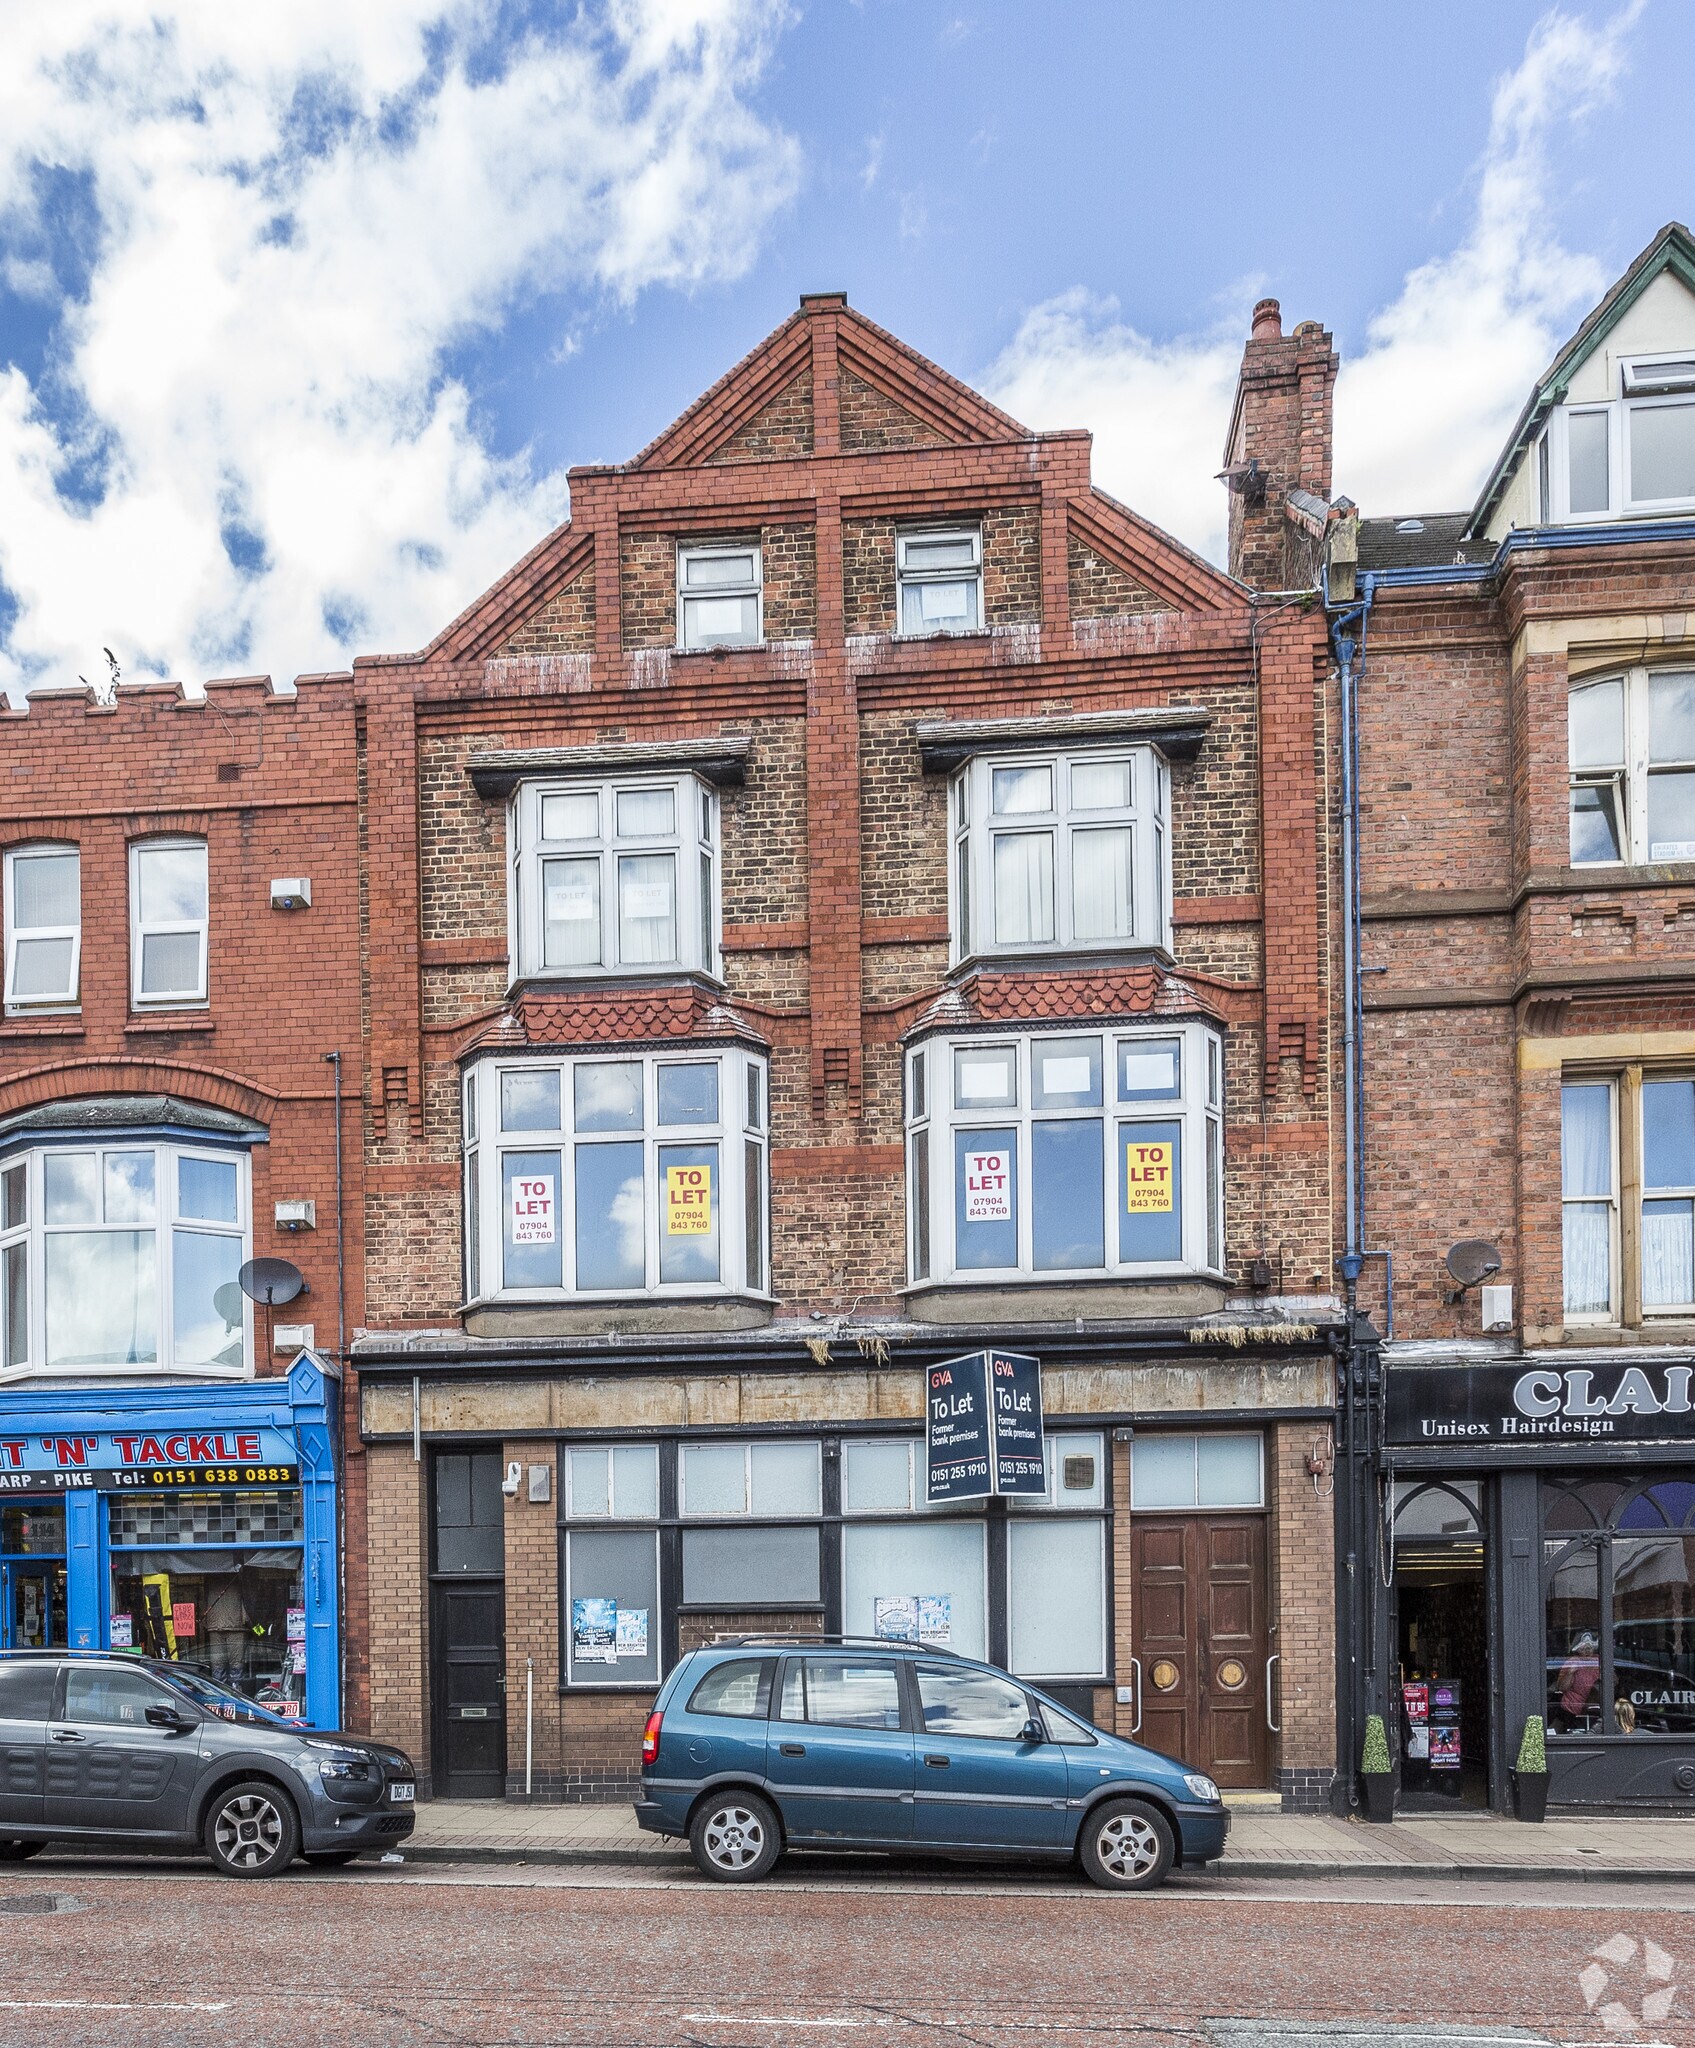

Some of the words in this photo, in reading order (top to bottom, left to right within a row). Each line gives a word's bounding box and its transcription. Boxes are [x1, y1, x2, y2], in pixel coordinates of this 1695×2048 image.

[1136, 1148, 1163, 1163] TO
[974, 1156, 1001, 1171] TO
[676, 1171, 702, 1186] TO
[1130, 1167, 1168, 1182] LET
[520, 1182, 546, 1197] TO
[969, 1175, 1006, 1191] LET
[670, 1190, 707, 1205] LET
[1134, 1189, 1164, 1197] 07904
[515, 1200, 551, 1216] LET
[973, 1197, 1003, 1206] 07904
[1130, 1198, 1149, 1208] 843
[1151, 1198, 1170, 1207] 760
[674, 1211, 704, 1220] 07904
[969, 1207, 988, 1216] 843
[990, 1206, 1008, 1215] 760
[520, 1222, 548, 1231] 07904
[670, 1221, 690, 1230] 843
[690, 1220, 708, 1229] 760
[516, 1232, 534, 1240] 843
[535, 1231, 552, 1240] 760
[994, 1360, 1014, 1378] GVA
[931, 1370, 953, 1389] GVA
[1513, 1366, 1695, 1418] CLAI
[931, 1397, 948, 1420] To
[951, 1392, 974, 1417] Let
[996, 1388, 1012, 1410] To
[1013, 1389, 1032, 1413] Let
[998, 1414, 1017, 1426] Former
[1421, 1419, 1490, 1437] Unisex
[1501, 1416, 1615, 1437] Hairdesign
[932, 1424, 954, 1436] Former
[998, 1427, 1013, 1438] bank
[1014, 1428, 1036, 1440] premises
[932, 1434, 948, 1447] bank
[950, 1430, 978, 1446] premises
[0, 1439, 29, 1469] T
[40, 1435, 99, 1467] 'N'
[111, 1432, 263, 1466] TACKLE
[931, 1468, 948, 1482] 0151
[950, 1466, 966, 1480] 255
[968, 1462, 987, 1477] 1910
[1000, 1461, 1014, 1474] 0151
[1015, 1462, 1028, 1475] 255
[1029, 1462, 1042, 1476] 1910
[54, 1472, 94, 1486] PIKE
[112, 1472, 146, 1484] Tel:
[153, 1470, 196, 1484] 0151
[204, 1469, 238, 1482] 638
[246, 1468, 290, 1482] 0883
[1630, 1690, 1695, 1705] CLAIR
